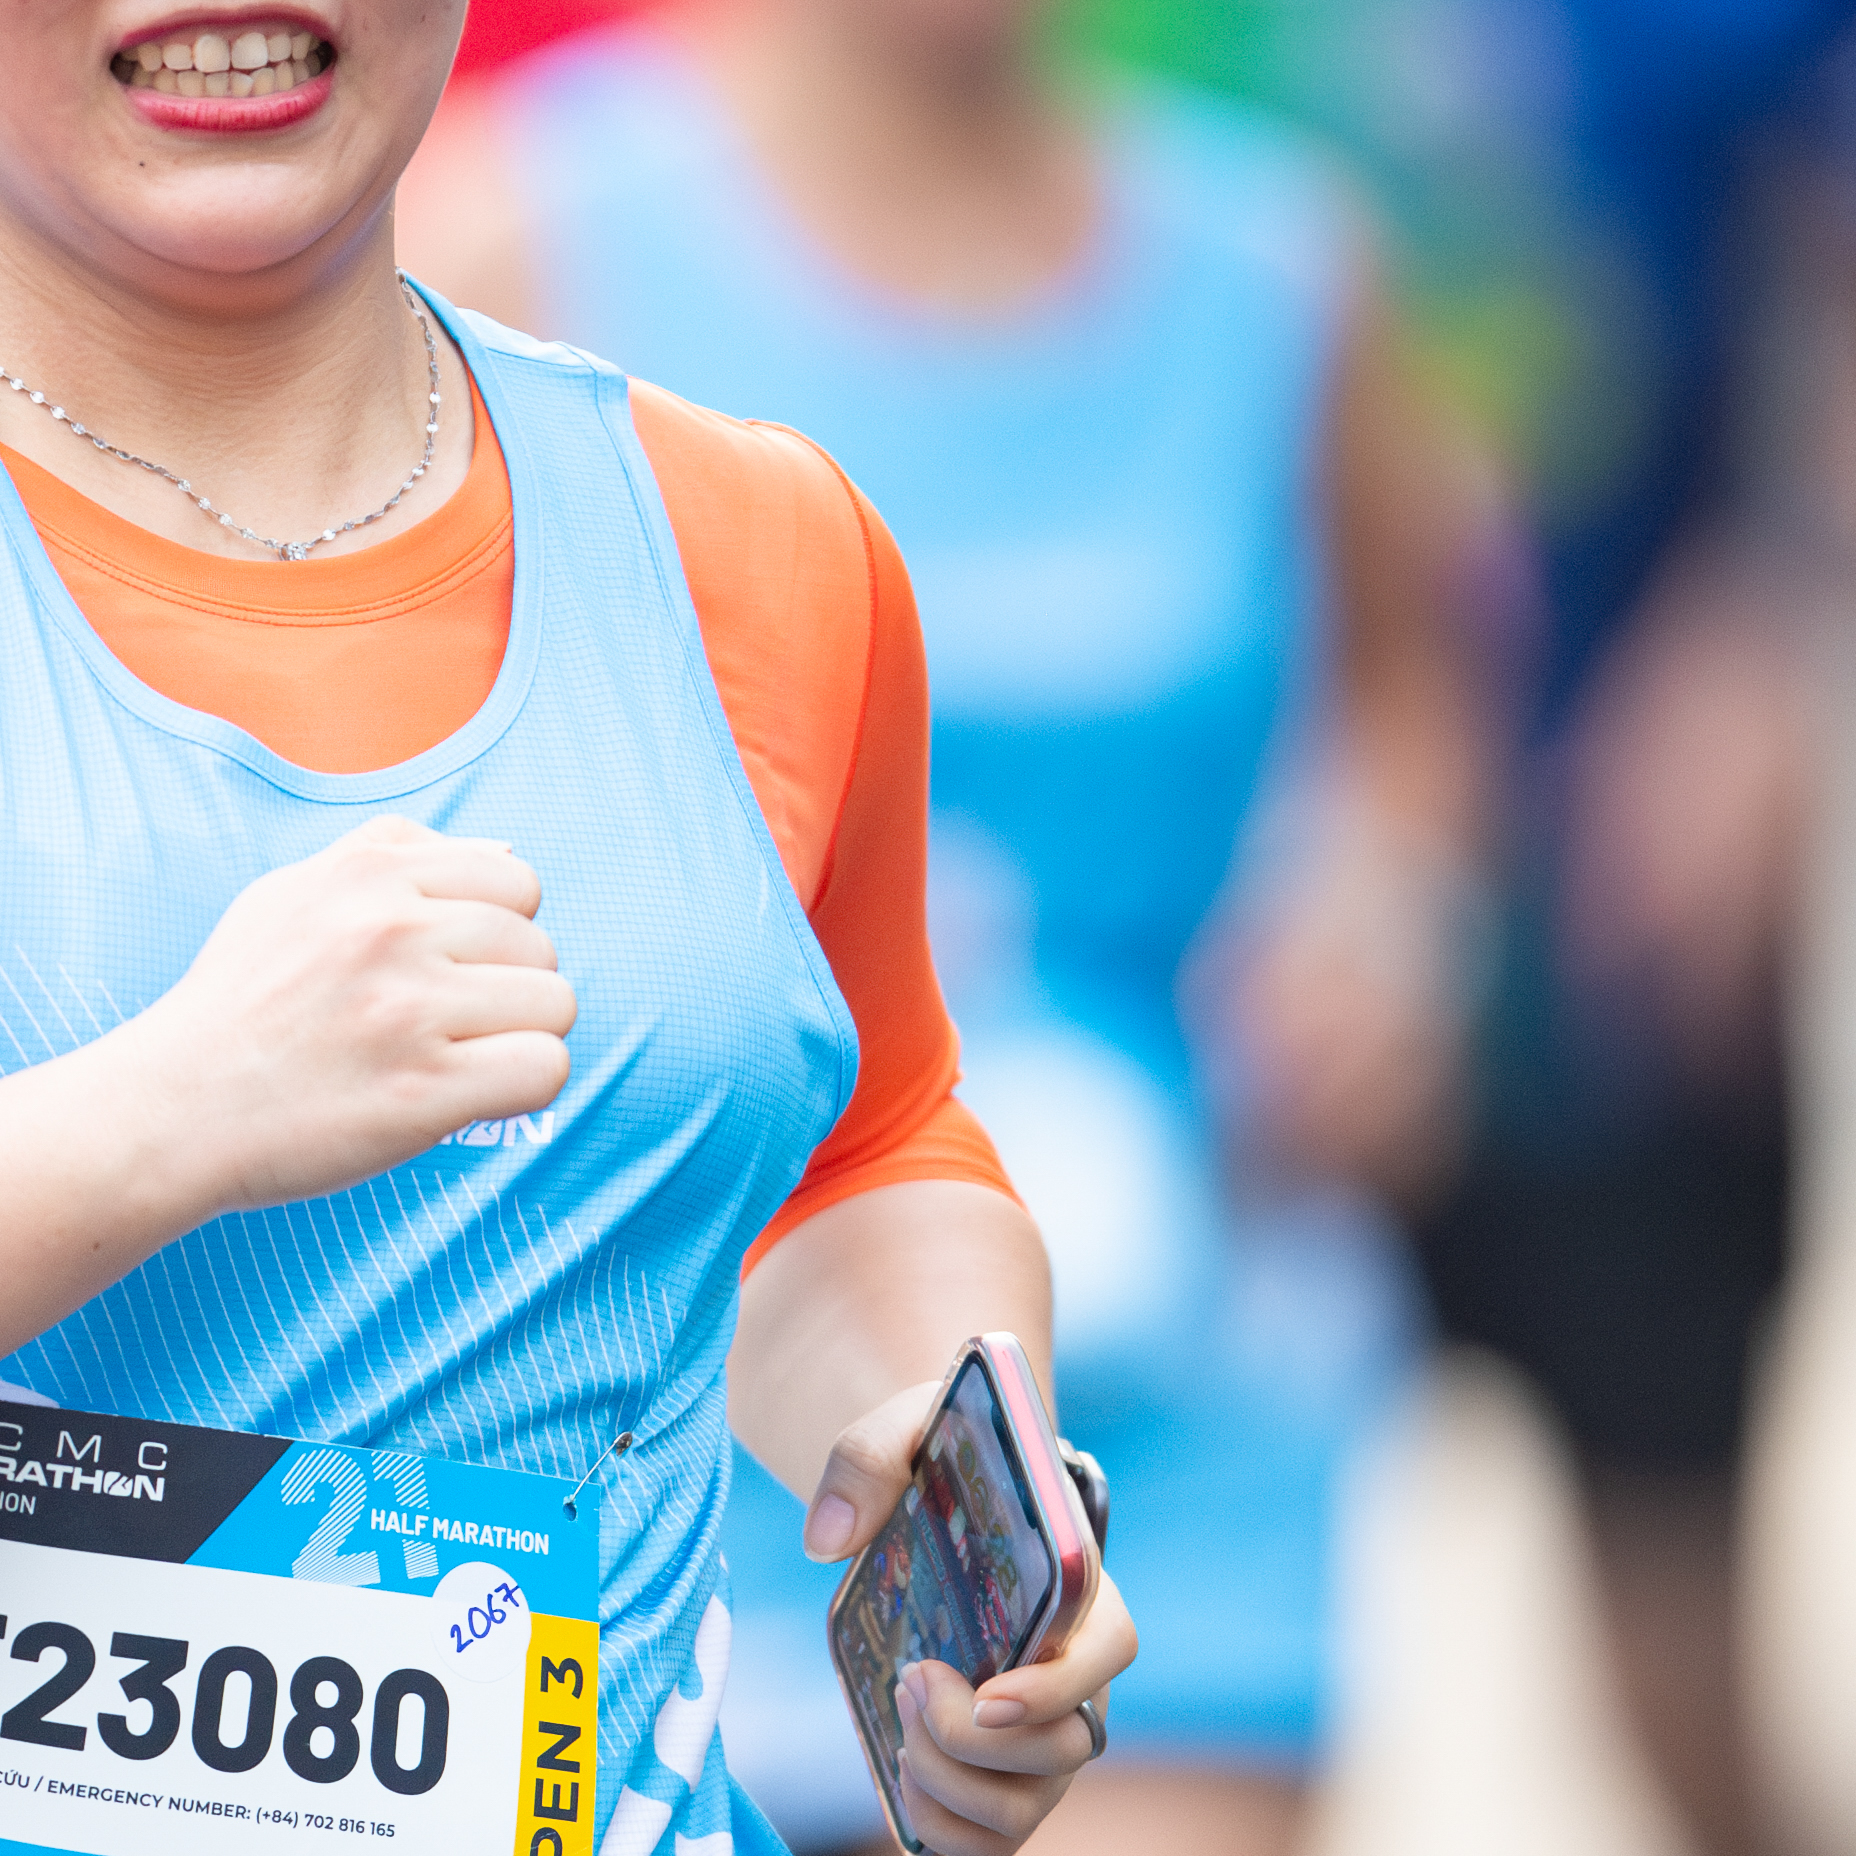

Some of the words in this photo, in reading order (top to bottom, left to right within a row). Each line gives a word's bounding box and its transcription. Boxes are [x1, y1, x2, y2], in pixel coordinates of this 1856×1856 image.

[370, 1508, 429, 1536] HALF
[432, 1518, 549, 1555] MARATHON
[450, 1582, 520, 1653] 2067
[540, 1656, 583, 1699] 3
[47, 1780, 164, 1808] EMERGENCY
[168, 1796, 251, 1820] NUMBER:
[256, 1807, 299, 1829] (+84)
[304, 1813, 334, 1830] 702
[338, 1818, 365, 1834] 816
[370, 1821, 396, 1838] 165
